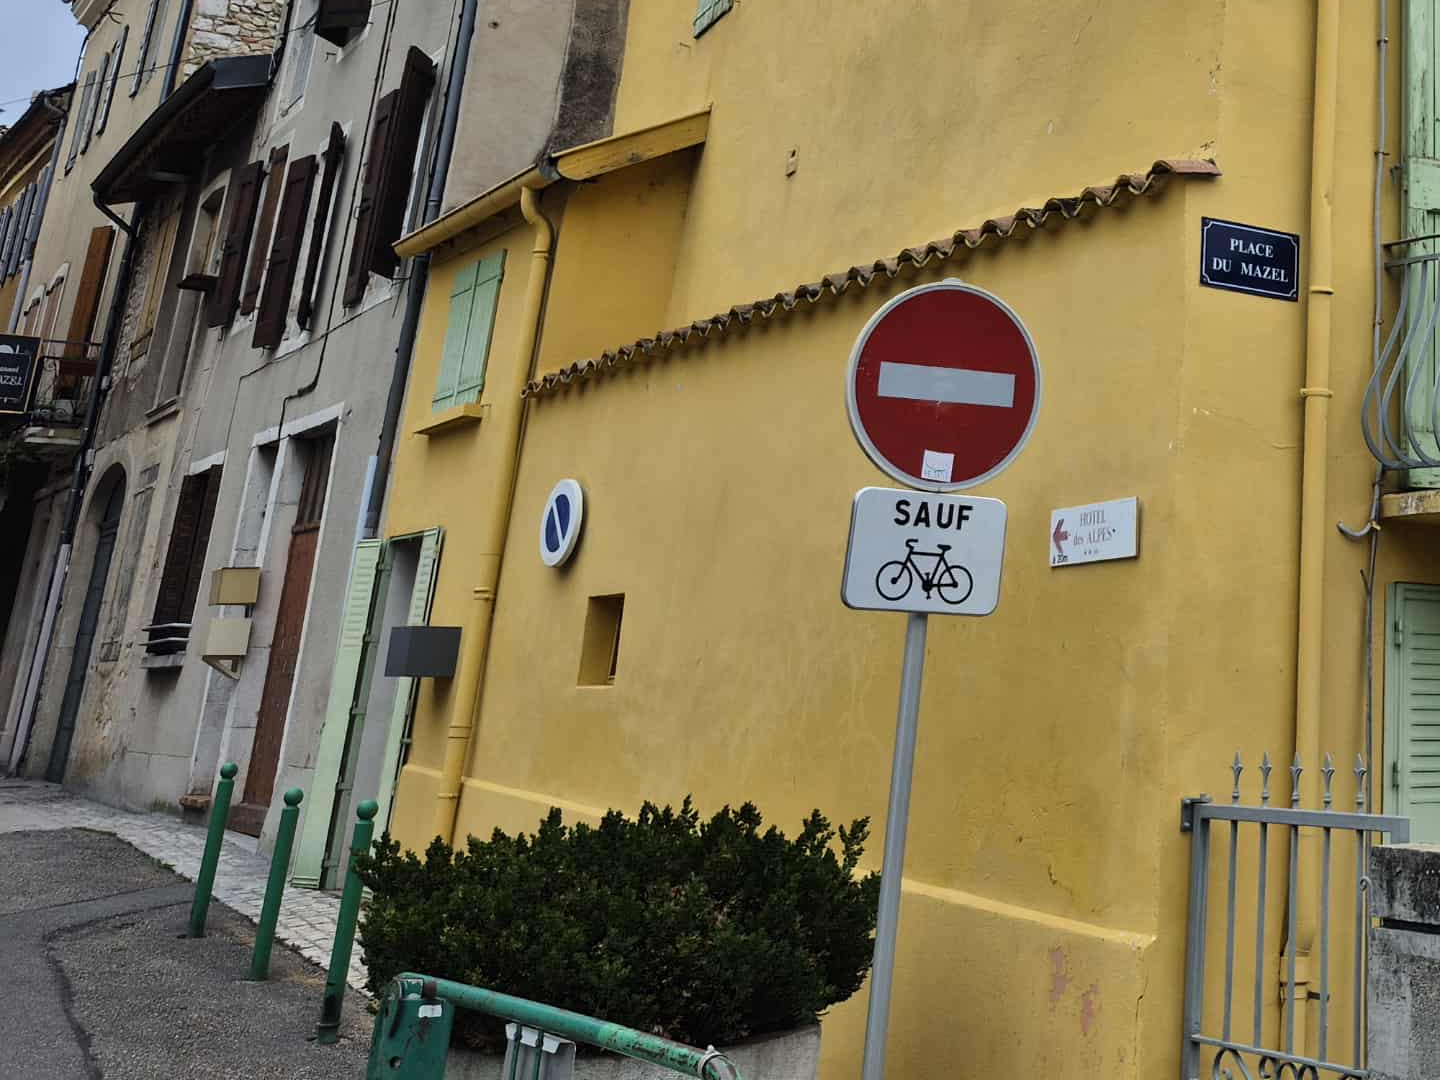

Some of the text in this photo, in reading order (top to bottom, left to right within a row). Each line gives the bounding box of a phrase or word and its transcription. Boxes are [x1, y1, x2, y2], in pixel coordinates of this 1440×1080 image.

[1230, 238, 1274, 258] PLACE
[1212, 257, 1289, 282] DU MAZEL
[894, 499, 974, 530] SAUF
